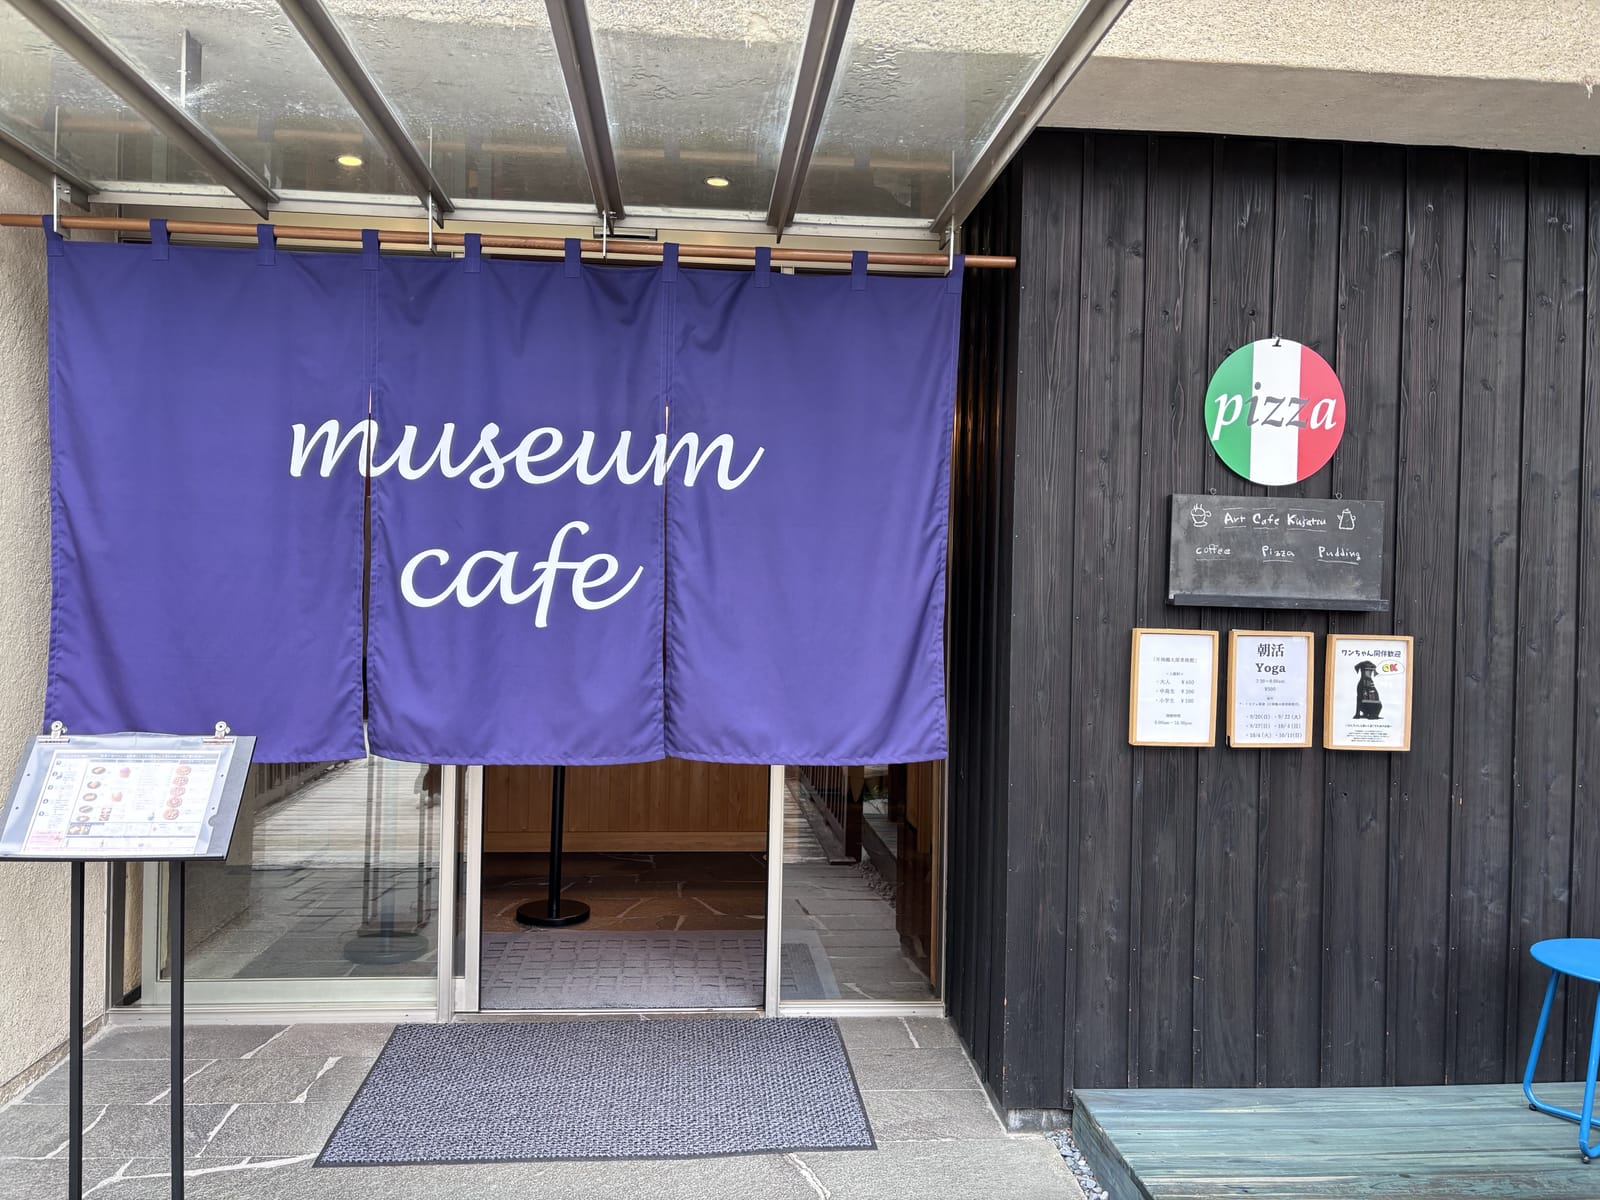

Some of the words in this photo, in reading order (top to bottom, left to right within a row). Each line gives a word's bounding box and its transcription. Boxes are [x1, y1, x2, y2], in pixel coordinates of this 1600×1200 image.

[1211, 381, 1337, 442] pizza
[289, 419, 765, 490] museum
[1223, 512, 1247, 525] Art
[1252, 513, 1280, 526] Cafe
[1195, 544, 1232, 556] coffee
[1261, 545, 1296, 558] Pizza
[1318, 545, 1361, 561] Pudding
[400, 520, 644, 628] cafe
[1257, 643, 1285, 657] 朝活
[1255, 663, 1286, 675] Yoga
